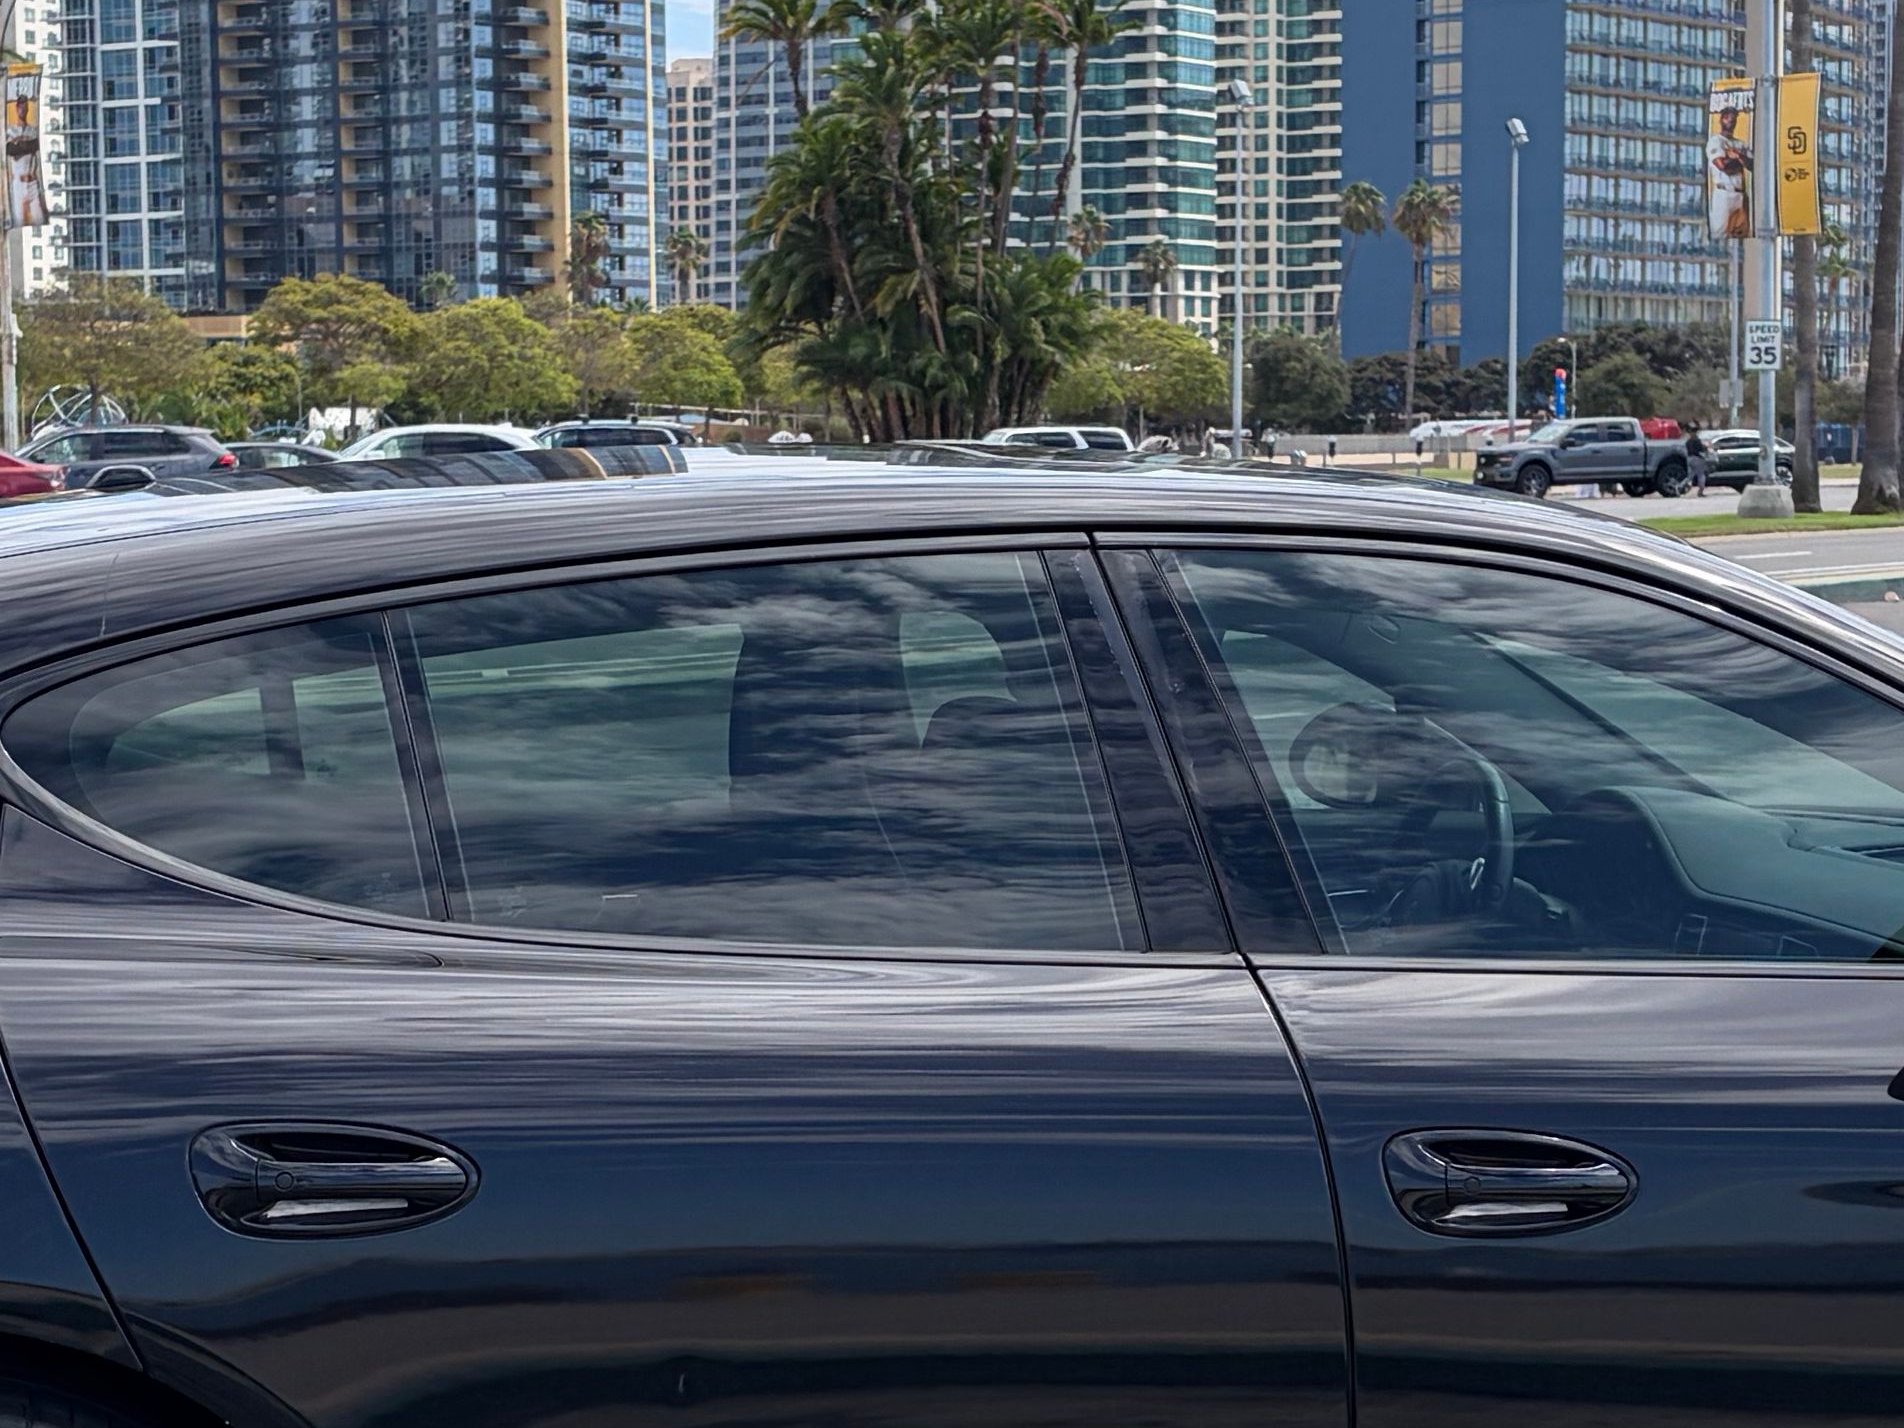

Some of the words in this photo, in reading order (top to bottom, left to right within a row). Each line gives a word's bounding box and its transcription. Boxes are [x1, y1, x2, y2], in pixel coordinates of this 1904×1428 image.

[1749, 324, 1780, 333] SPEED
[1751, 336, 1776, 344] LIMIT
[1750, 346, 1777, 364] 35
